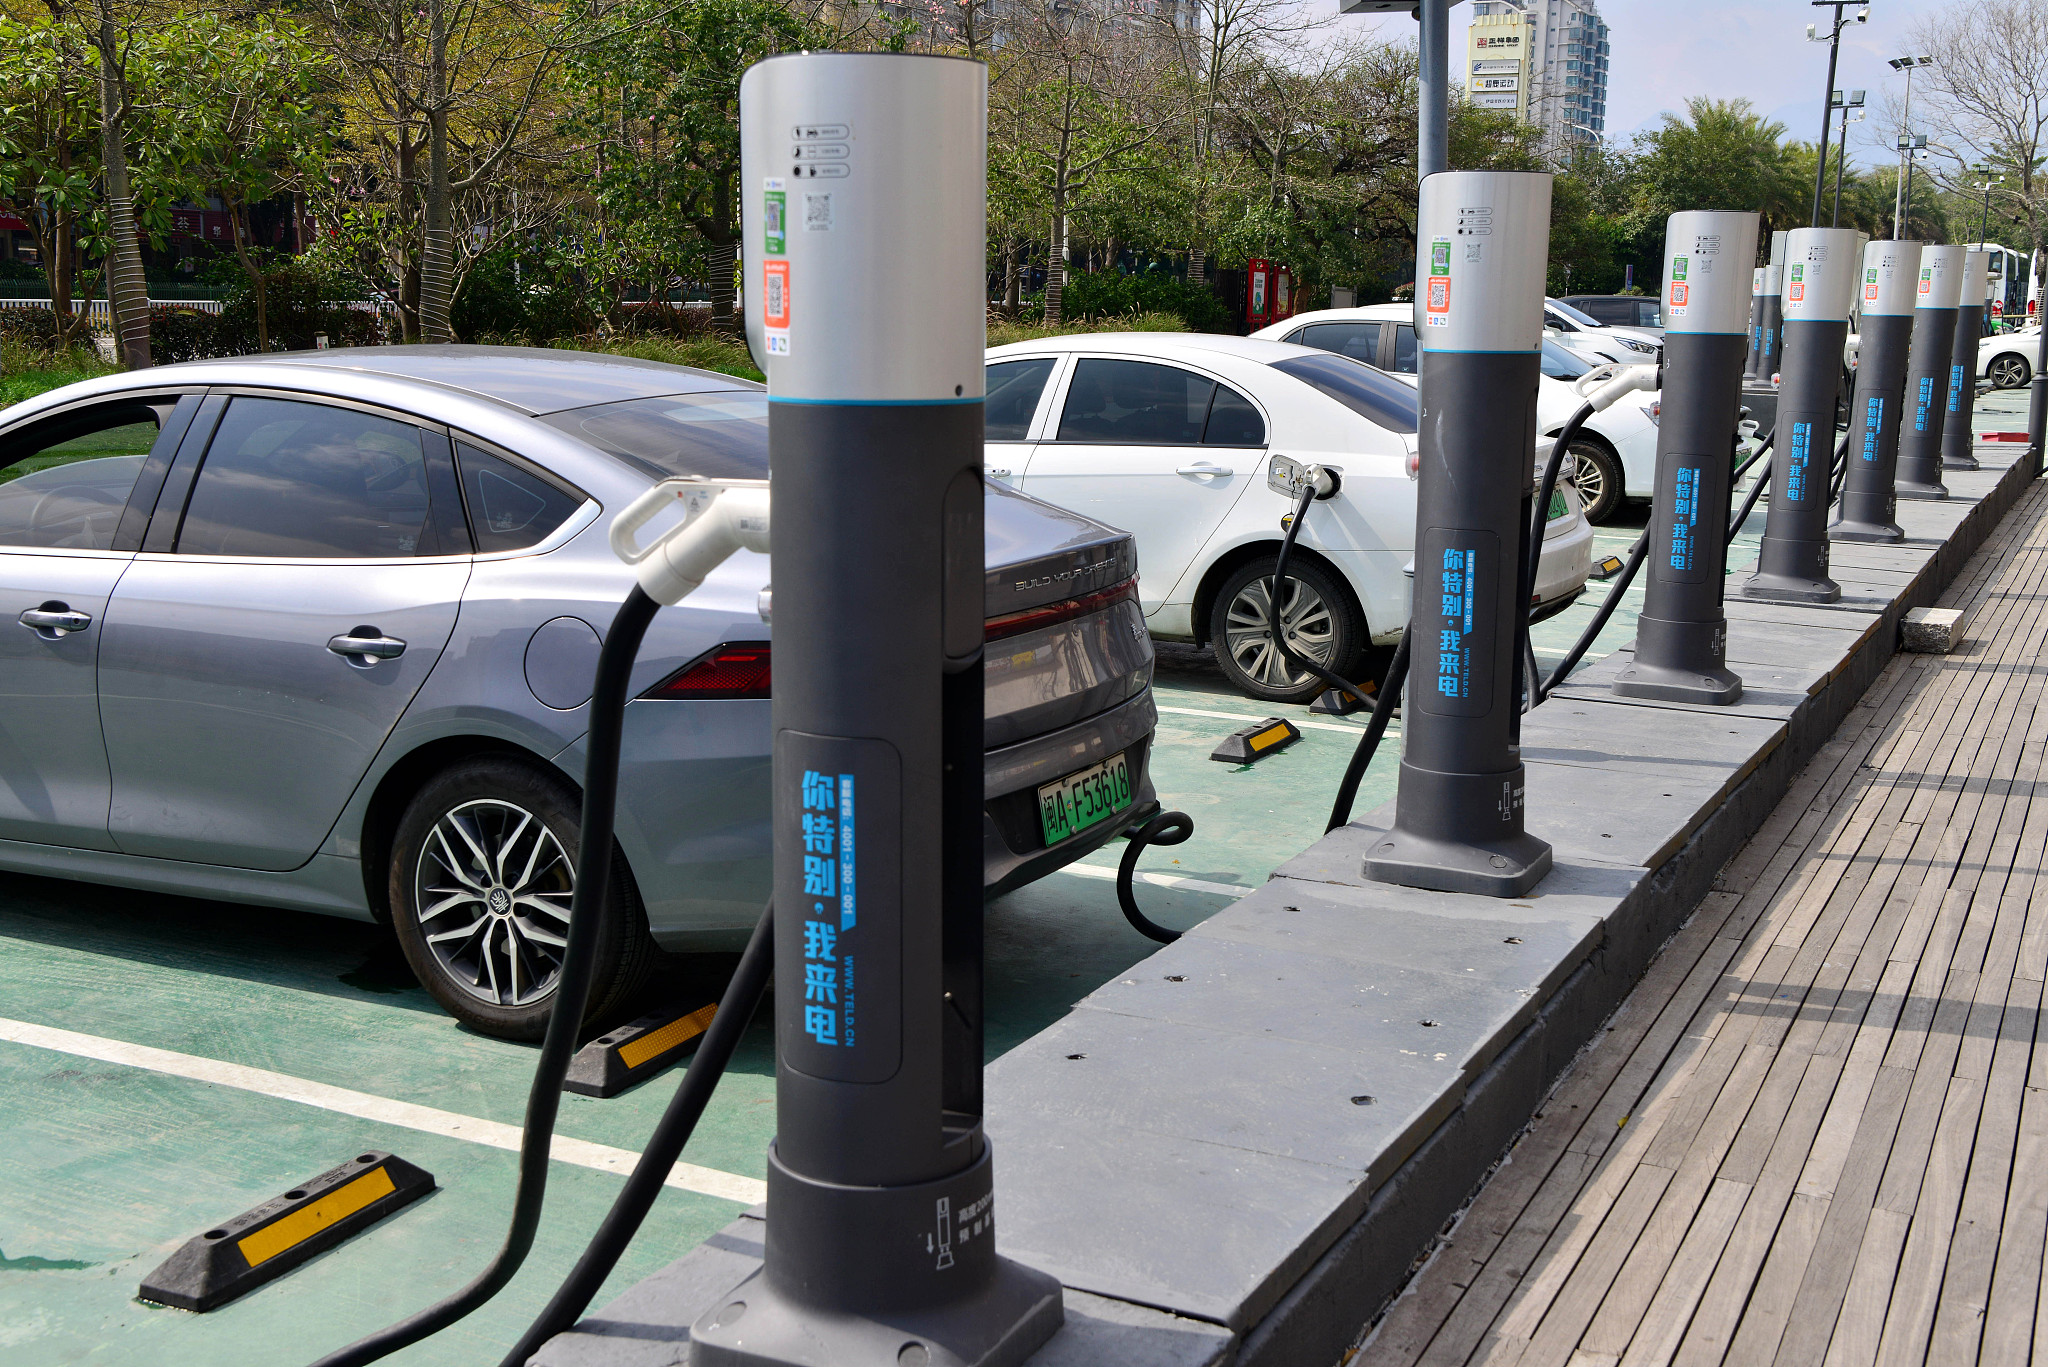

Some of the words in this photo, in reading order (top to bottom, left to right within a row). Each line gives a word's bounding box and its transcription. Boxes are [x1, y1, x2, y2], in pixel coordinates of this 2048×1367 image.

[1670, 467, 1692, 570] 你特别·我来电
[1015, 576, 1051, 591] BUILD
[1054, 568, 1082, 582] YOUR
[1084, 558, 1118, 575] DREAMS
[1438, 548, 1464, 698] 你特别·我来电
[801, 770, 839, 1046] 你特别·我来电
[844, 955, 856, 1048] WWW.TELD.CN
